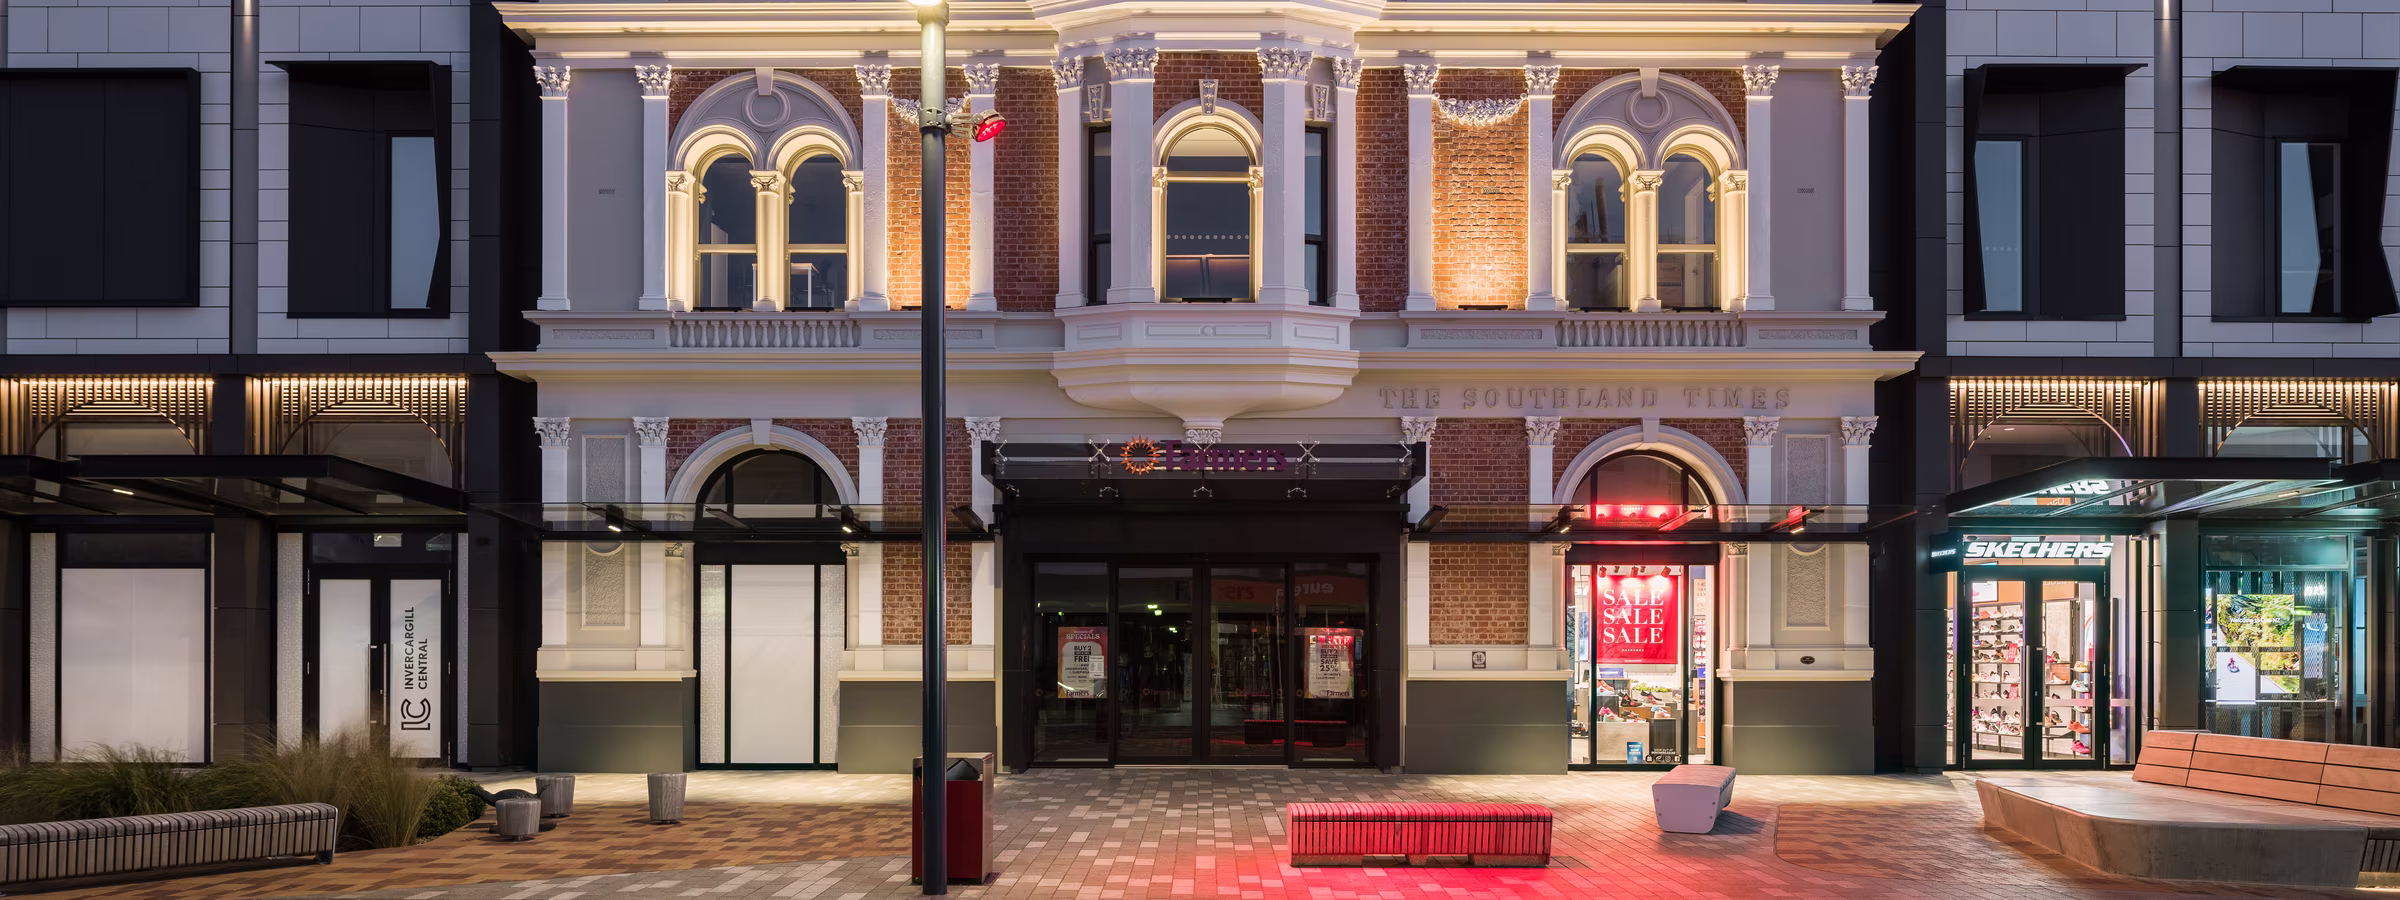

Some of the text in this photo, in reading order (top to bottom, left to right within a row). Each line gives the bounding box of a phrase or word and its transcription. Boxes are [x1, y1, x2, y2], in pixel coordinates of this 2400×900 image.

[1379, 387, 1791, 409] THE SOUTHLAND TIMES
[1165, 440, 1288, 472] Farmers
[1931, 548, 1956, 558] SKECHERS
[1965, 542, 2114, 558] SKECHERS
[1603, 588, 1664, 606] SALE
[1603, 608, 1664, 625] SALE
[1603, 627, 1664, 644] SALE
[404, 607, 414, 689] INVERCARGILL
[418, 638, 428, 690] CENTRAL
